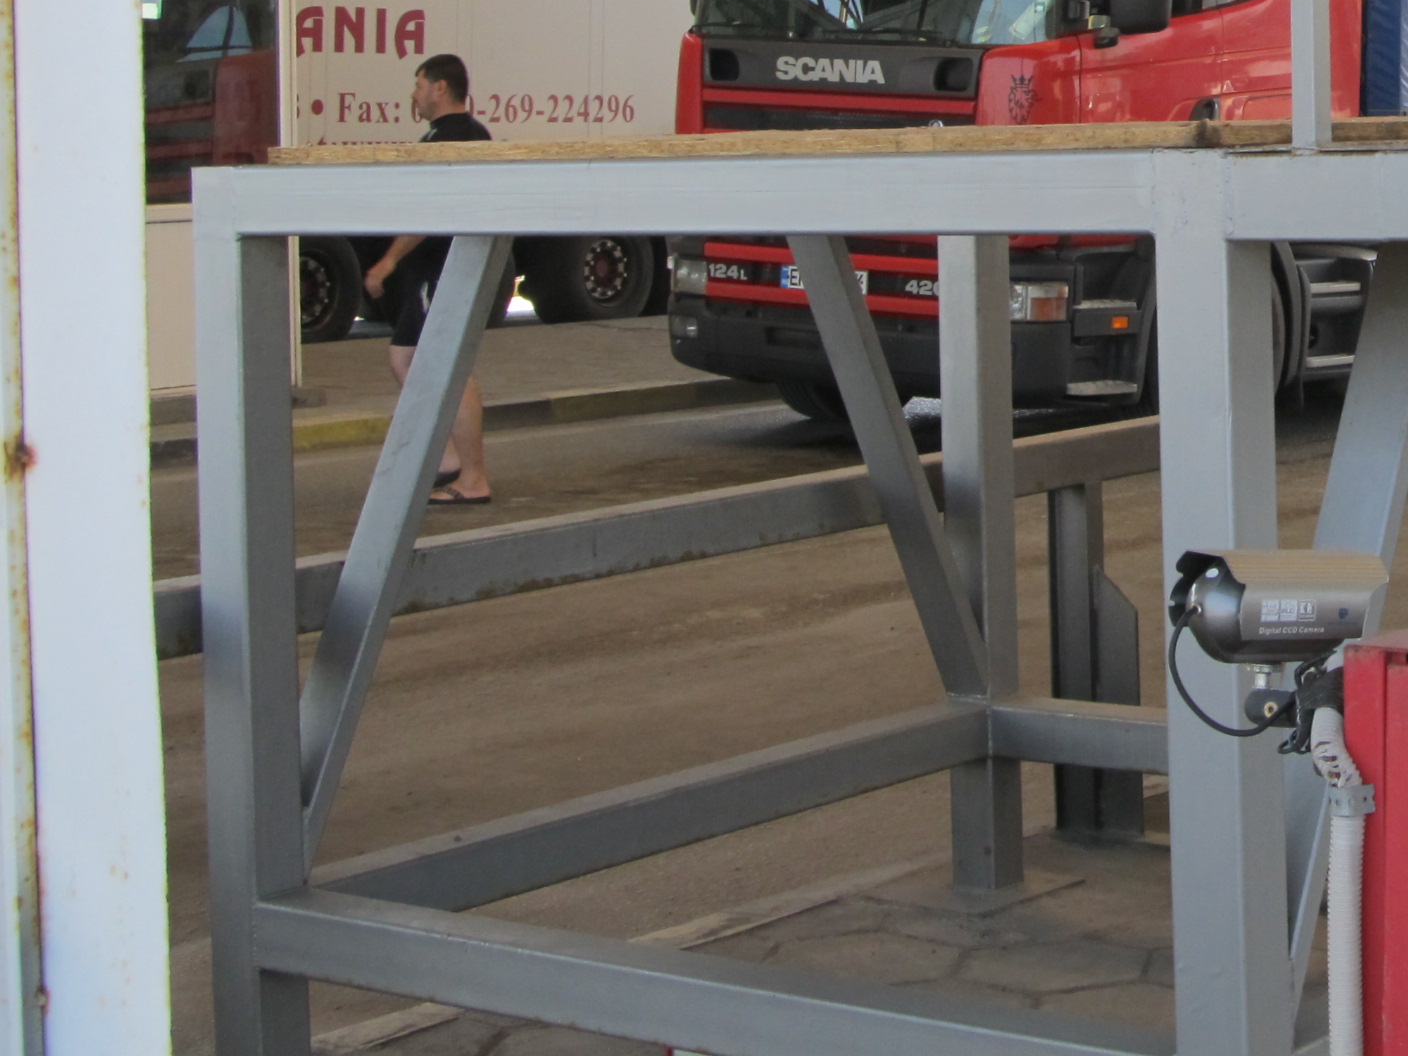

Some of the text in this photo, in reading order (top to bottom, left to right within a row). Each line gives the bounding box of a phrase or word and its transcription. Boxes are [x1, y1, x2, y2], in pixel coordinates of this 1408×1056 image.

[296, 6, 426, 60] ANIA
[775, 56, 885, 84] SCANIA
[336, 92, 401, 123] Fax:
[1259, 626, 1325, 636] Digital CCD Camera
